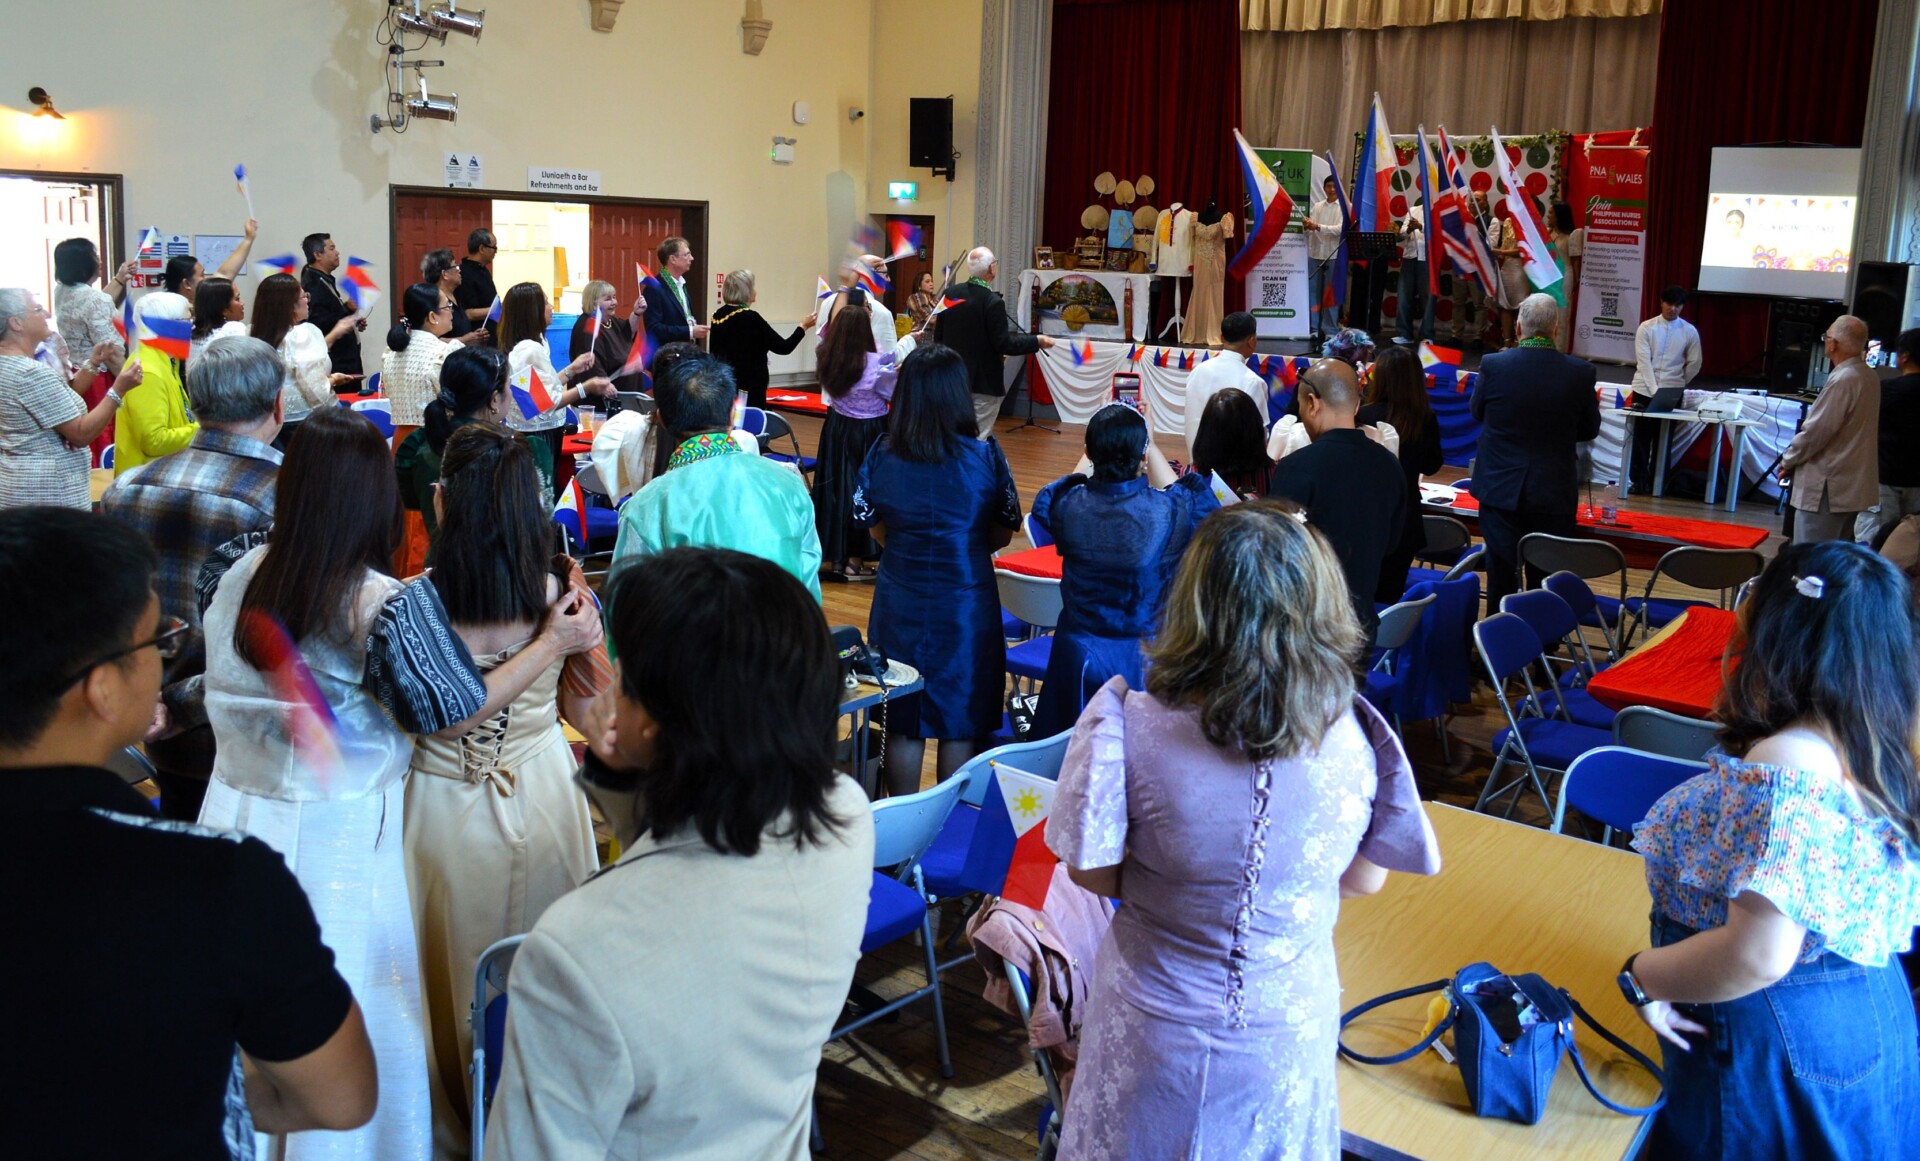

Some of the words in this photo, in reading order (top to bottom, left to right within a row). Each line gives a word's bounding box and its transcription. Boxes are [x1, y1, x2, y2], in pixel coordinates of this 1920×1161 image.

[541, 170, 570, 179] Lluniaeth
[577, 173, 588, 181] Bar
[1287, 168, 1305, 179] UK
[1590, 166, 1607, 176] PNA
[1616, 173, 1643, 184] WALES
[530, 180, 573, 190] Refreshments
[588, 184, 598, 192] Bar
[1586, 195, 1612, 214] Join
[1592, 210, 1621, 218] PHILIPPINE
[1594, 218, 1632, 226] ASSOCIATION
